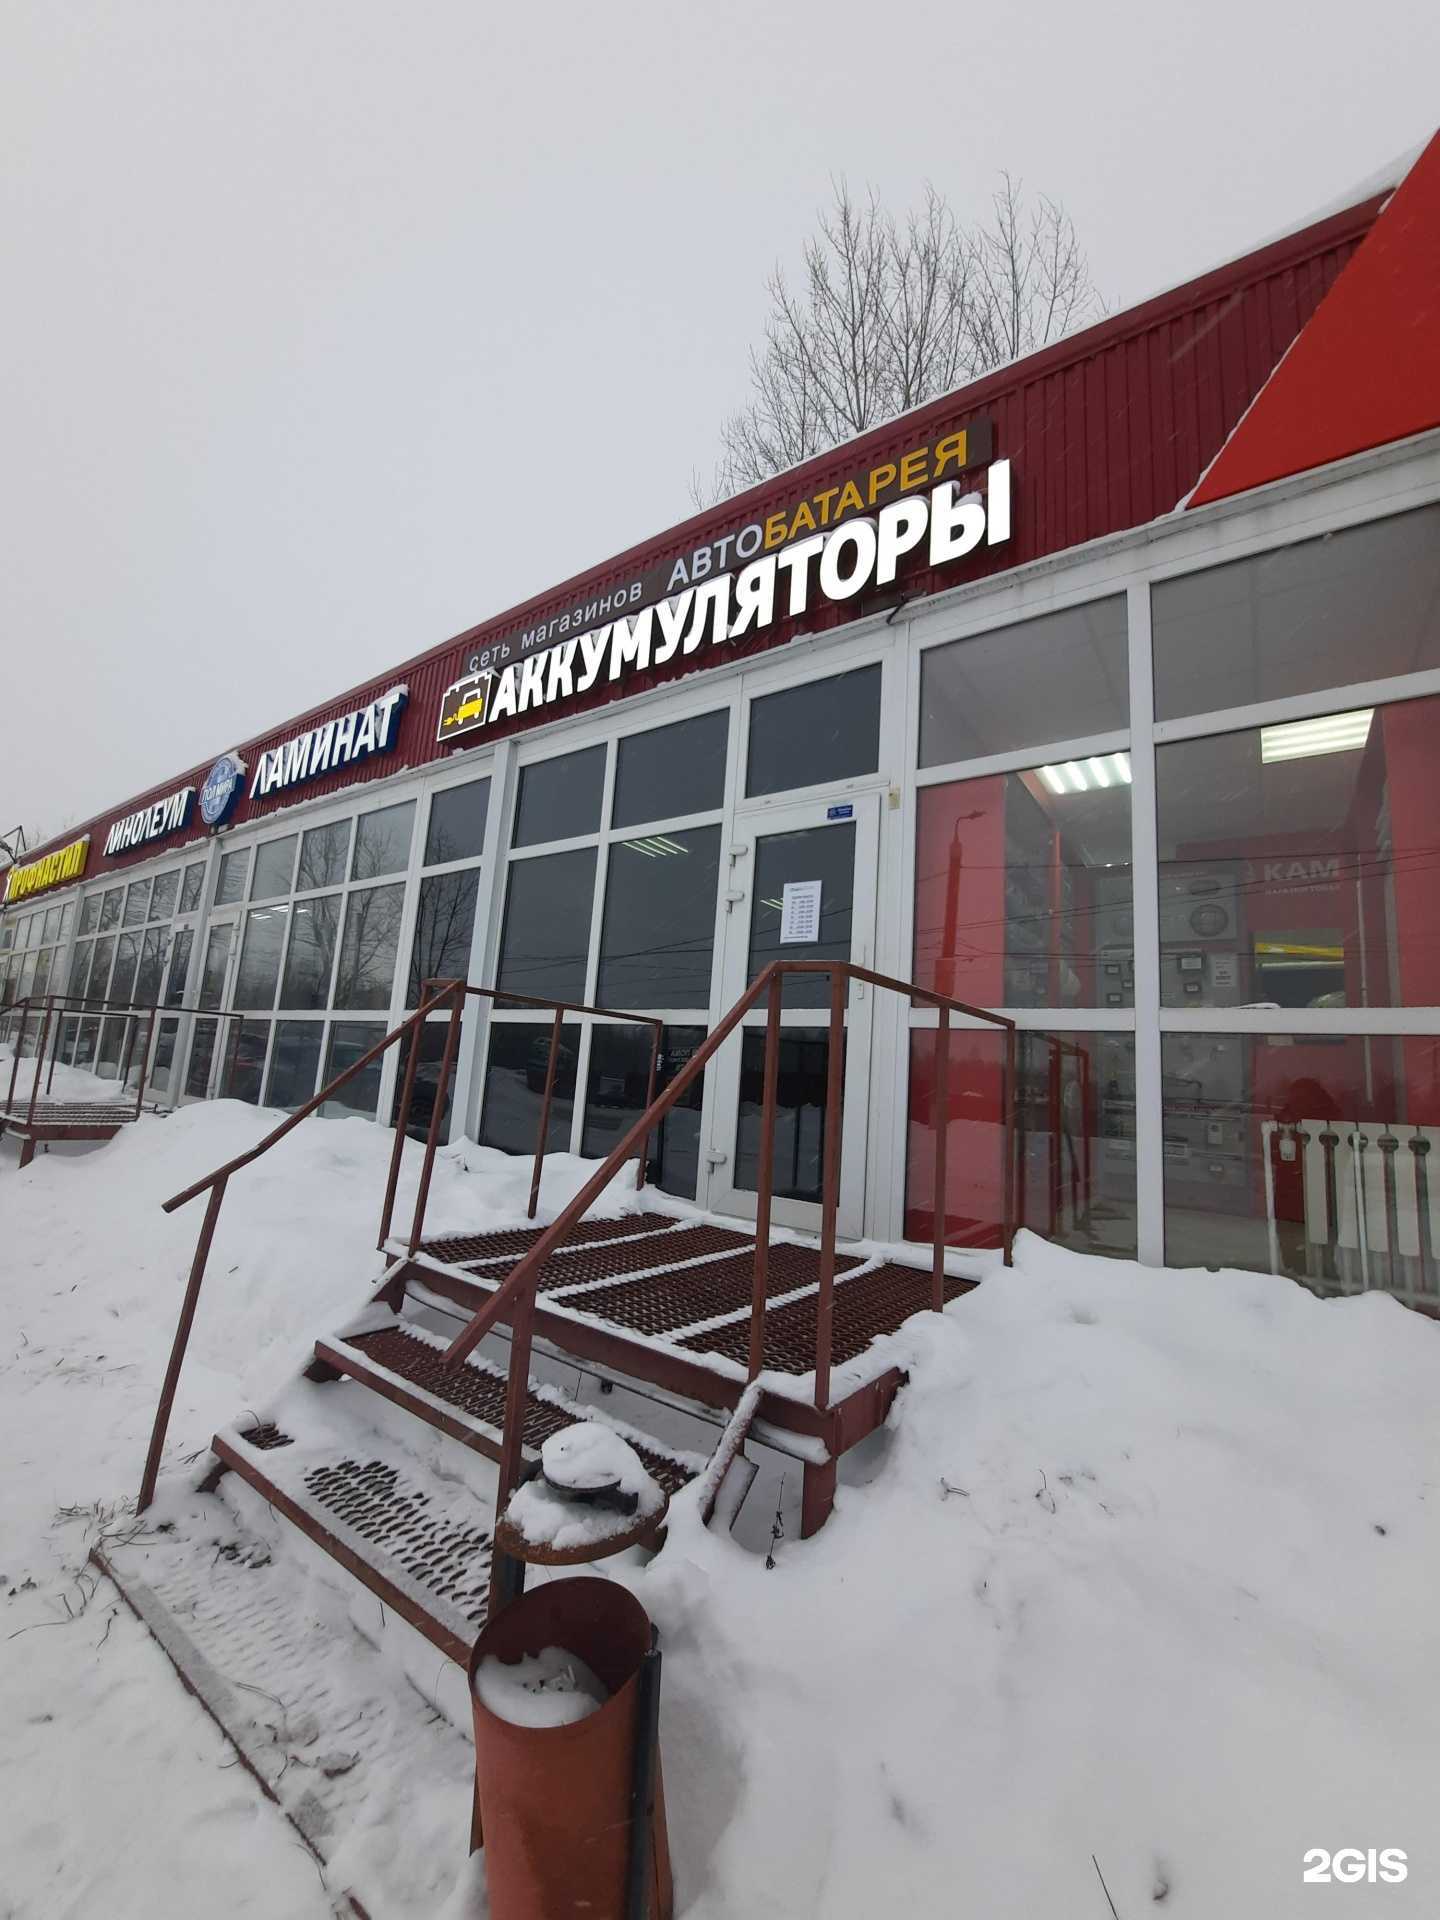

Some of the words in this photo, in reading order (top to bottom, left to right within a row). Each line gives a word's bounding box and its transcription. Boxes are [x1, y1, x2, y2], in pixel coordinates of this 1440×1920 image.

[469, 642, 511, 672] сеть
[521, 582, 642, 650] магазинов
[666, 430, 968, 592] АВТОБАТАРЕЯ
[488, 459, 1012, 722] АККУМУЛЯТОРЫ
[103, 788, 190, 856] ЛИНОЛЕУМ
[249, 692, 401, 799] ЛАМИНАТ
